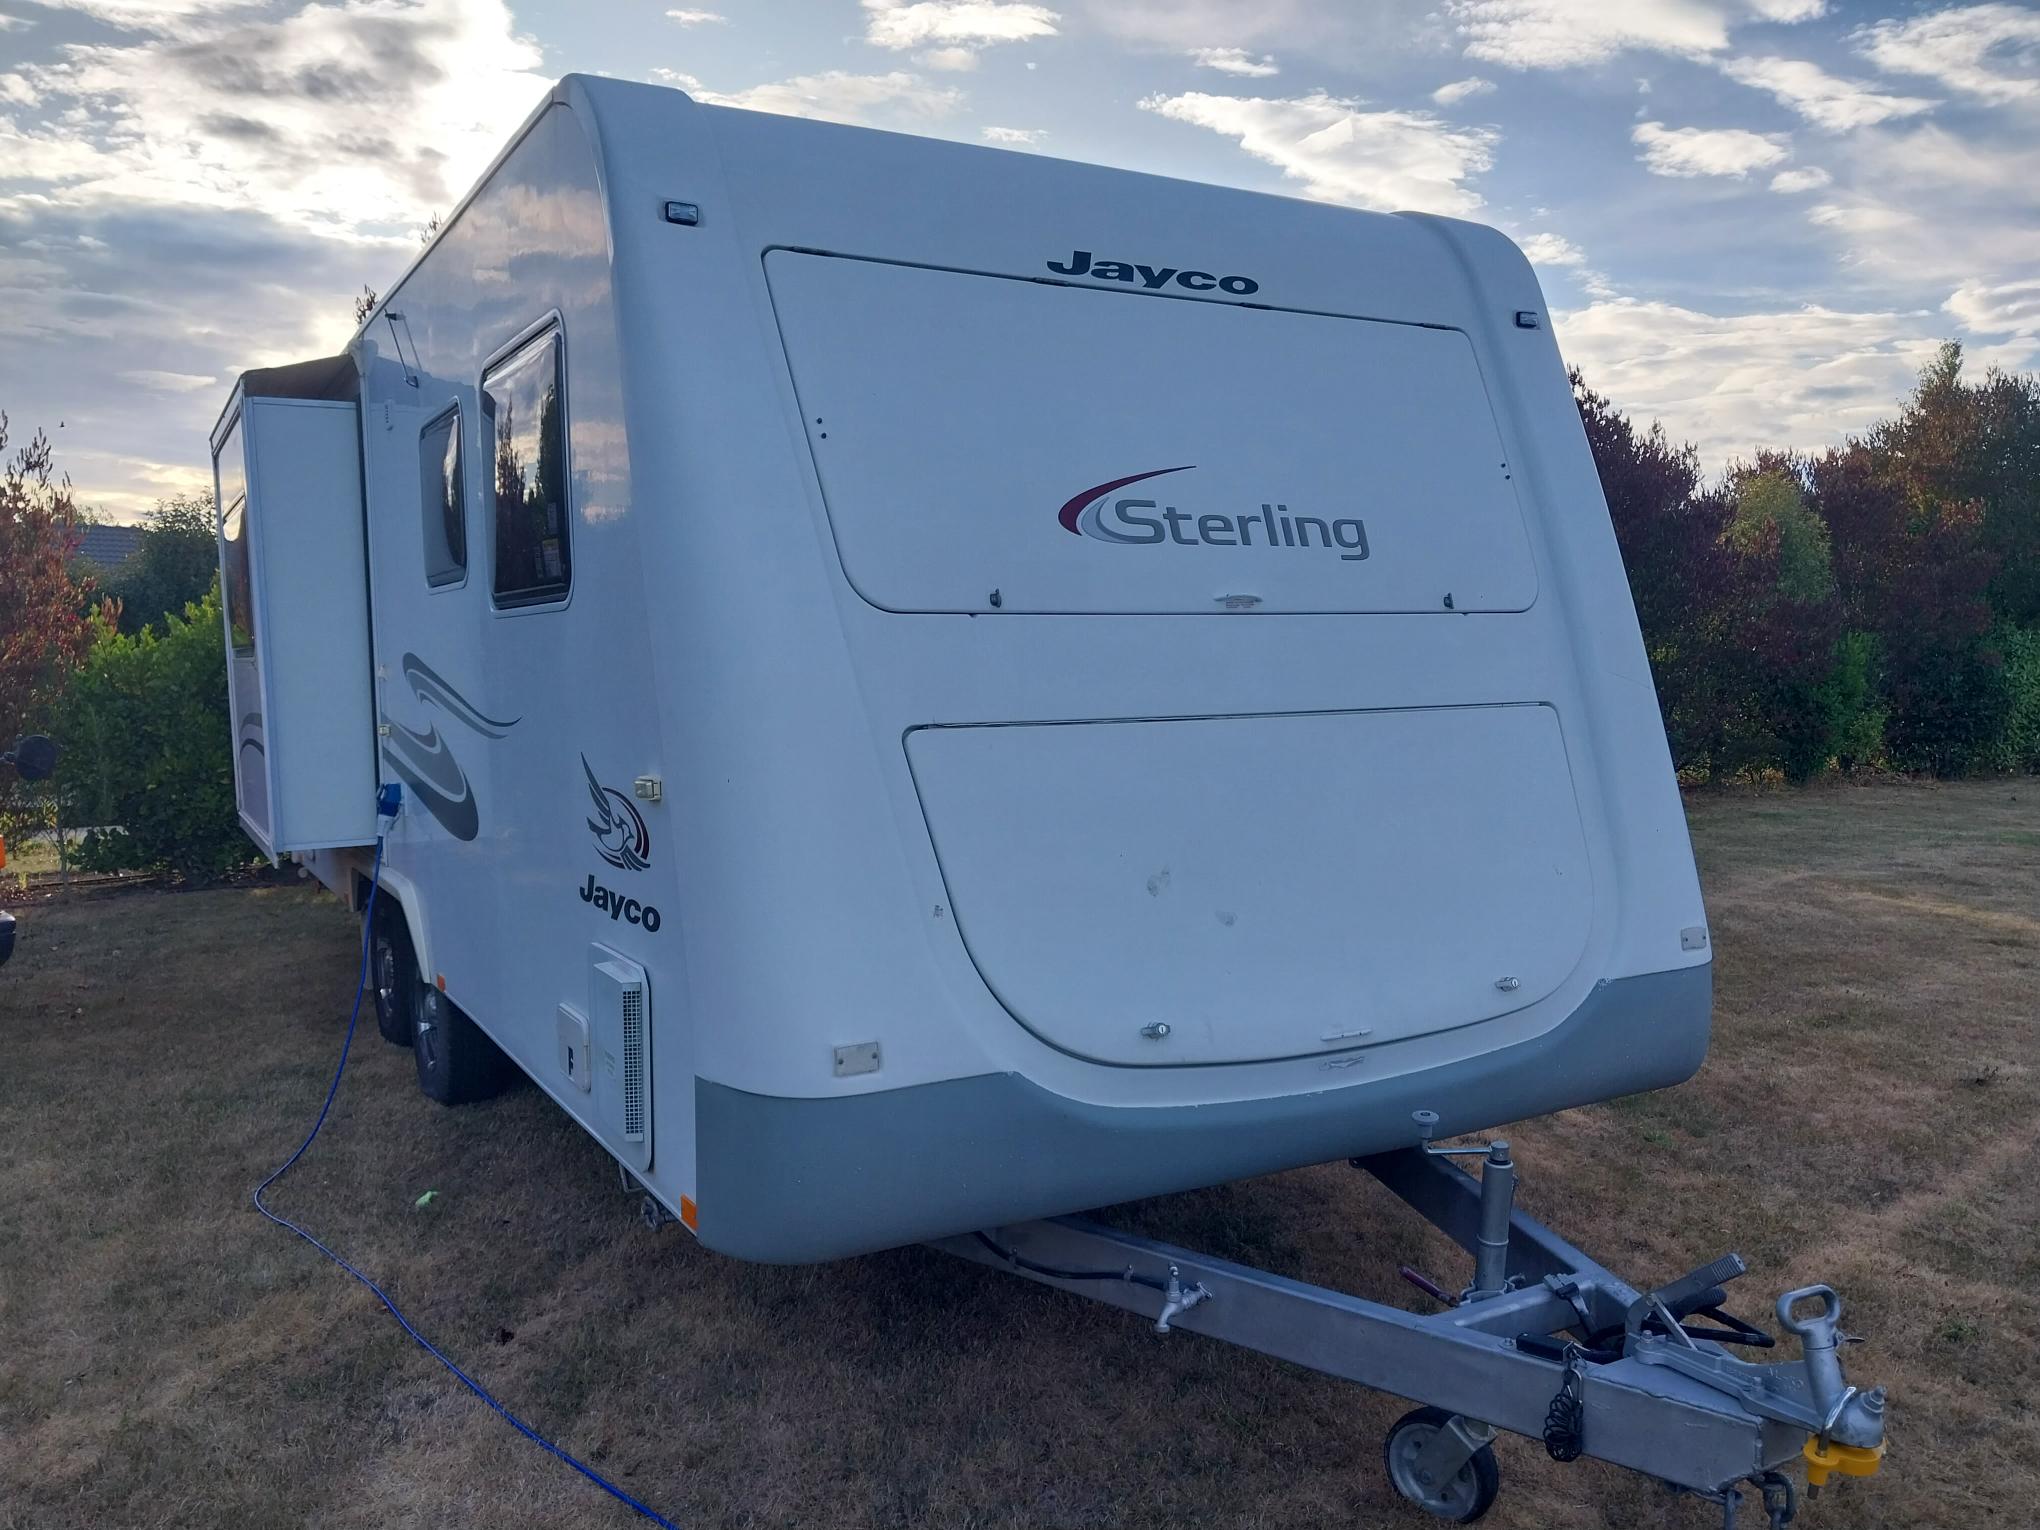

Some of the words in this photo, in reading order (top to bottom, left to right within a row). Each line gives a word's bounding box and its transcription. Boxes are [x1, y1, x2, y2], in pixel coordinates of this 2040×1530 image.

[1046, 250, 1260, 296] Jayco
[1114, 498, 1371, 561] Sterling
[579, 873, 661, 933] Jayco
